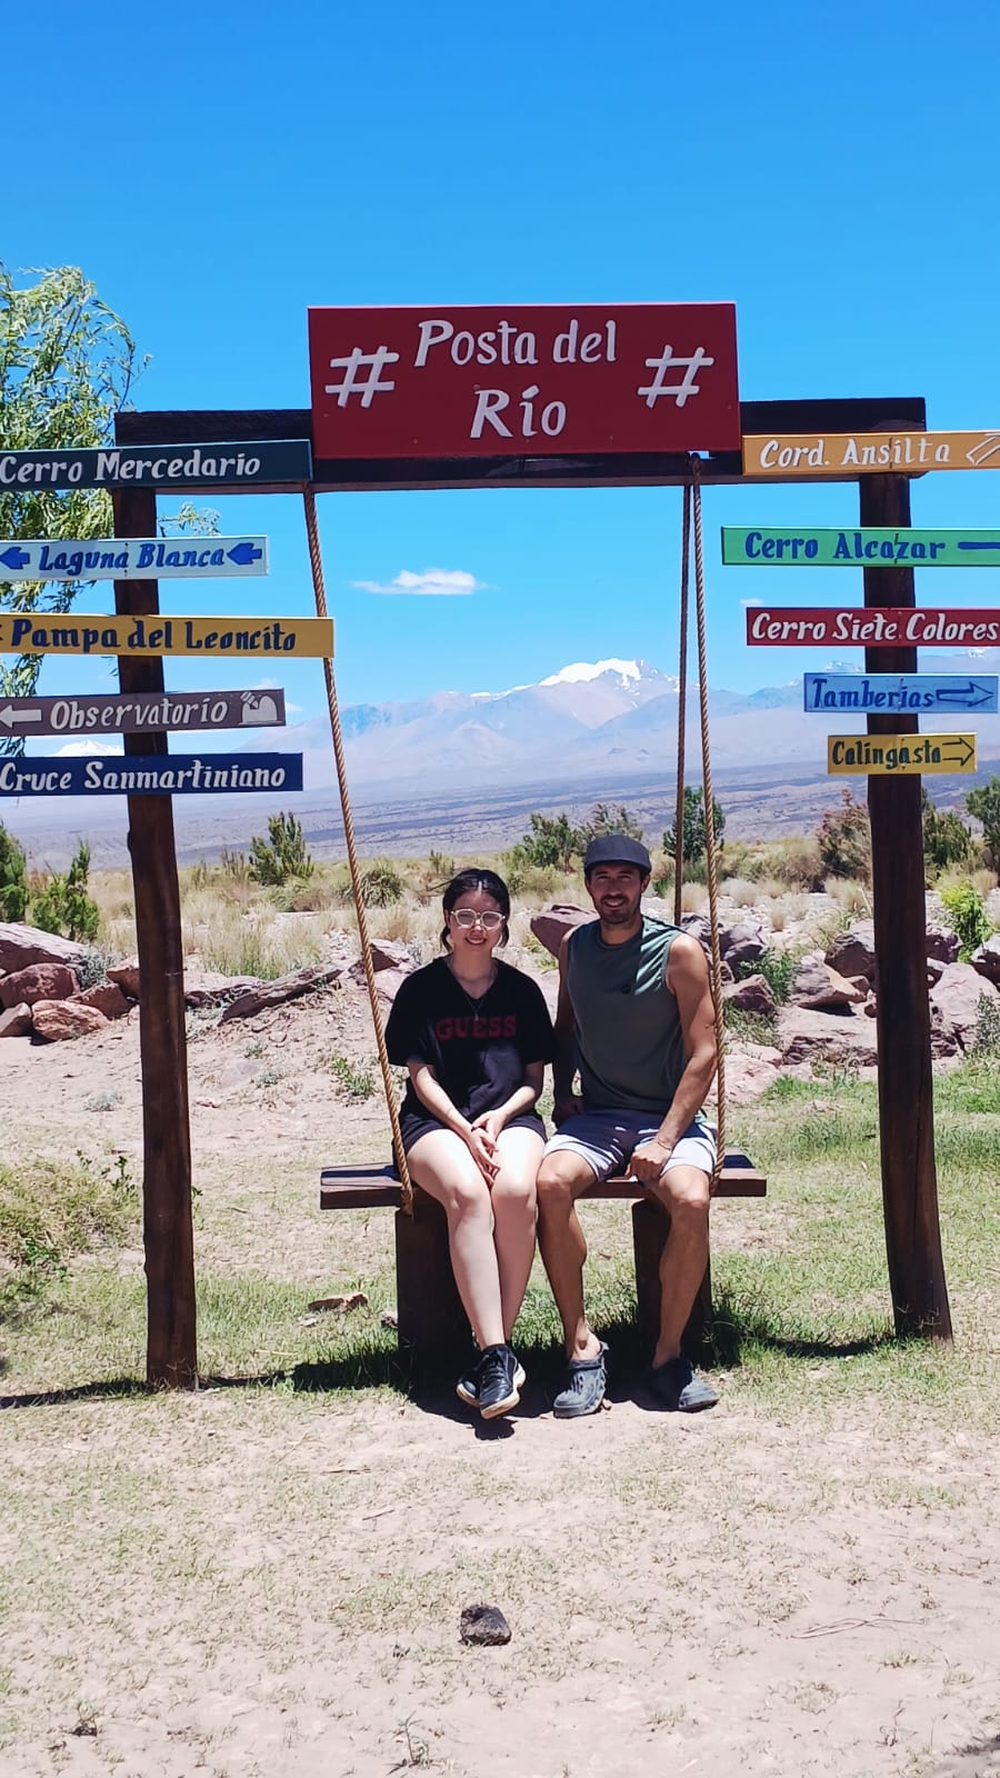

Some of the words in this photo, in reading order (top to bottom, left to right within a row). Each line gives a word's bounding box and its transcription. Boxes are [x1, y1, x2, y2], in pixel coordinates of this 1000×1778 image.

[413, 319, 539, 367] Posta
[552, 319, 618, 363] del
[469, 384, 567, 438] Río
[0, 455, 83, 483] Cerro
[94, 449, 261, 481] Mercedario
[759, 439, 831, 468] Cord.
[840, 437, 951, 466] Ansilta
[38, 545, 129, 576] Laguna
[136, 542, 226, 569] Blanca
[744, 531, 819, 559] Cerro
[832, 532, 946, 559] Alcazar
[11, 618, 121, 653] Pampa
[127, 618, 173, 648] del
[184, 620, 297, 651] Leoncito
[751, 612, 826, 640] Cerro
[832, 612, 898, 641] Siete
[905, 612, 999, 641] Colores
[50, 697, 229, 731] Observatorio
[832, 739, 942, 770] Calingasta
[0, 761, 73, 792] Cruce
[83, 759, 287, 792] Sanmartiniano
[435, 1015, 517, 1042] GUESS
